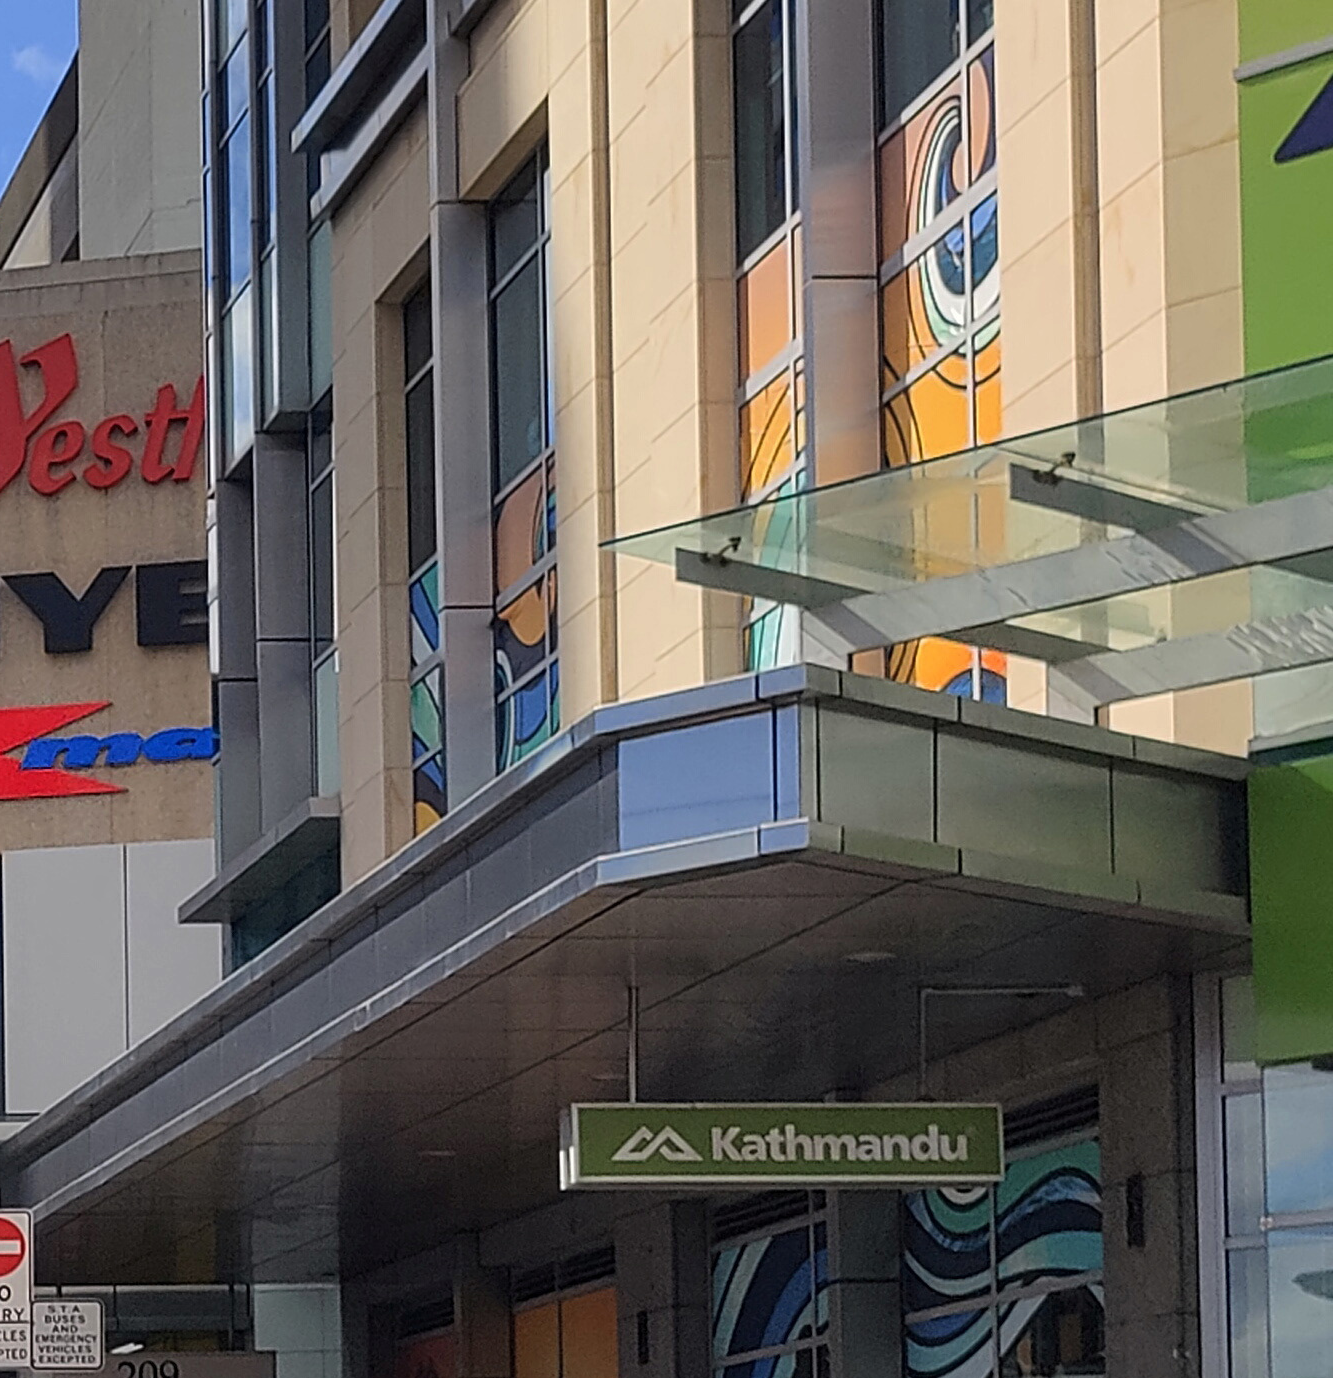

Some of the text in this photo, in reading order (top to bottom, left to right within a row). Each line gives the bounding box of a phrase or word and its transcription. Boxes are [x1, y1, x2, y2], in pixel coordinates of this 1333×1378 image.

[710, 1123, 969, 1162] Kathmandu
[44, 1315, 86, 1324] BUSES
[52, 1325, 79, 1334] AND
[35, 1334, 97, 1344] EMERGENCY
[38, 1345, 92, 1354] VEHICLES
[39, 1355, 96, 1364] EXCEPTED
